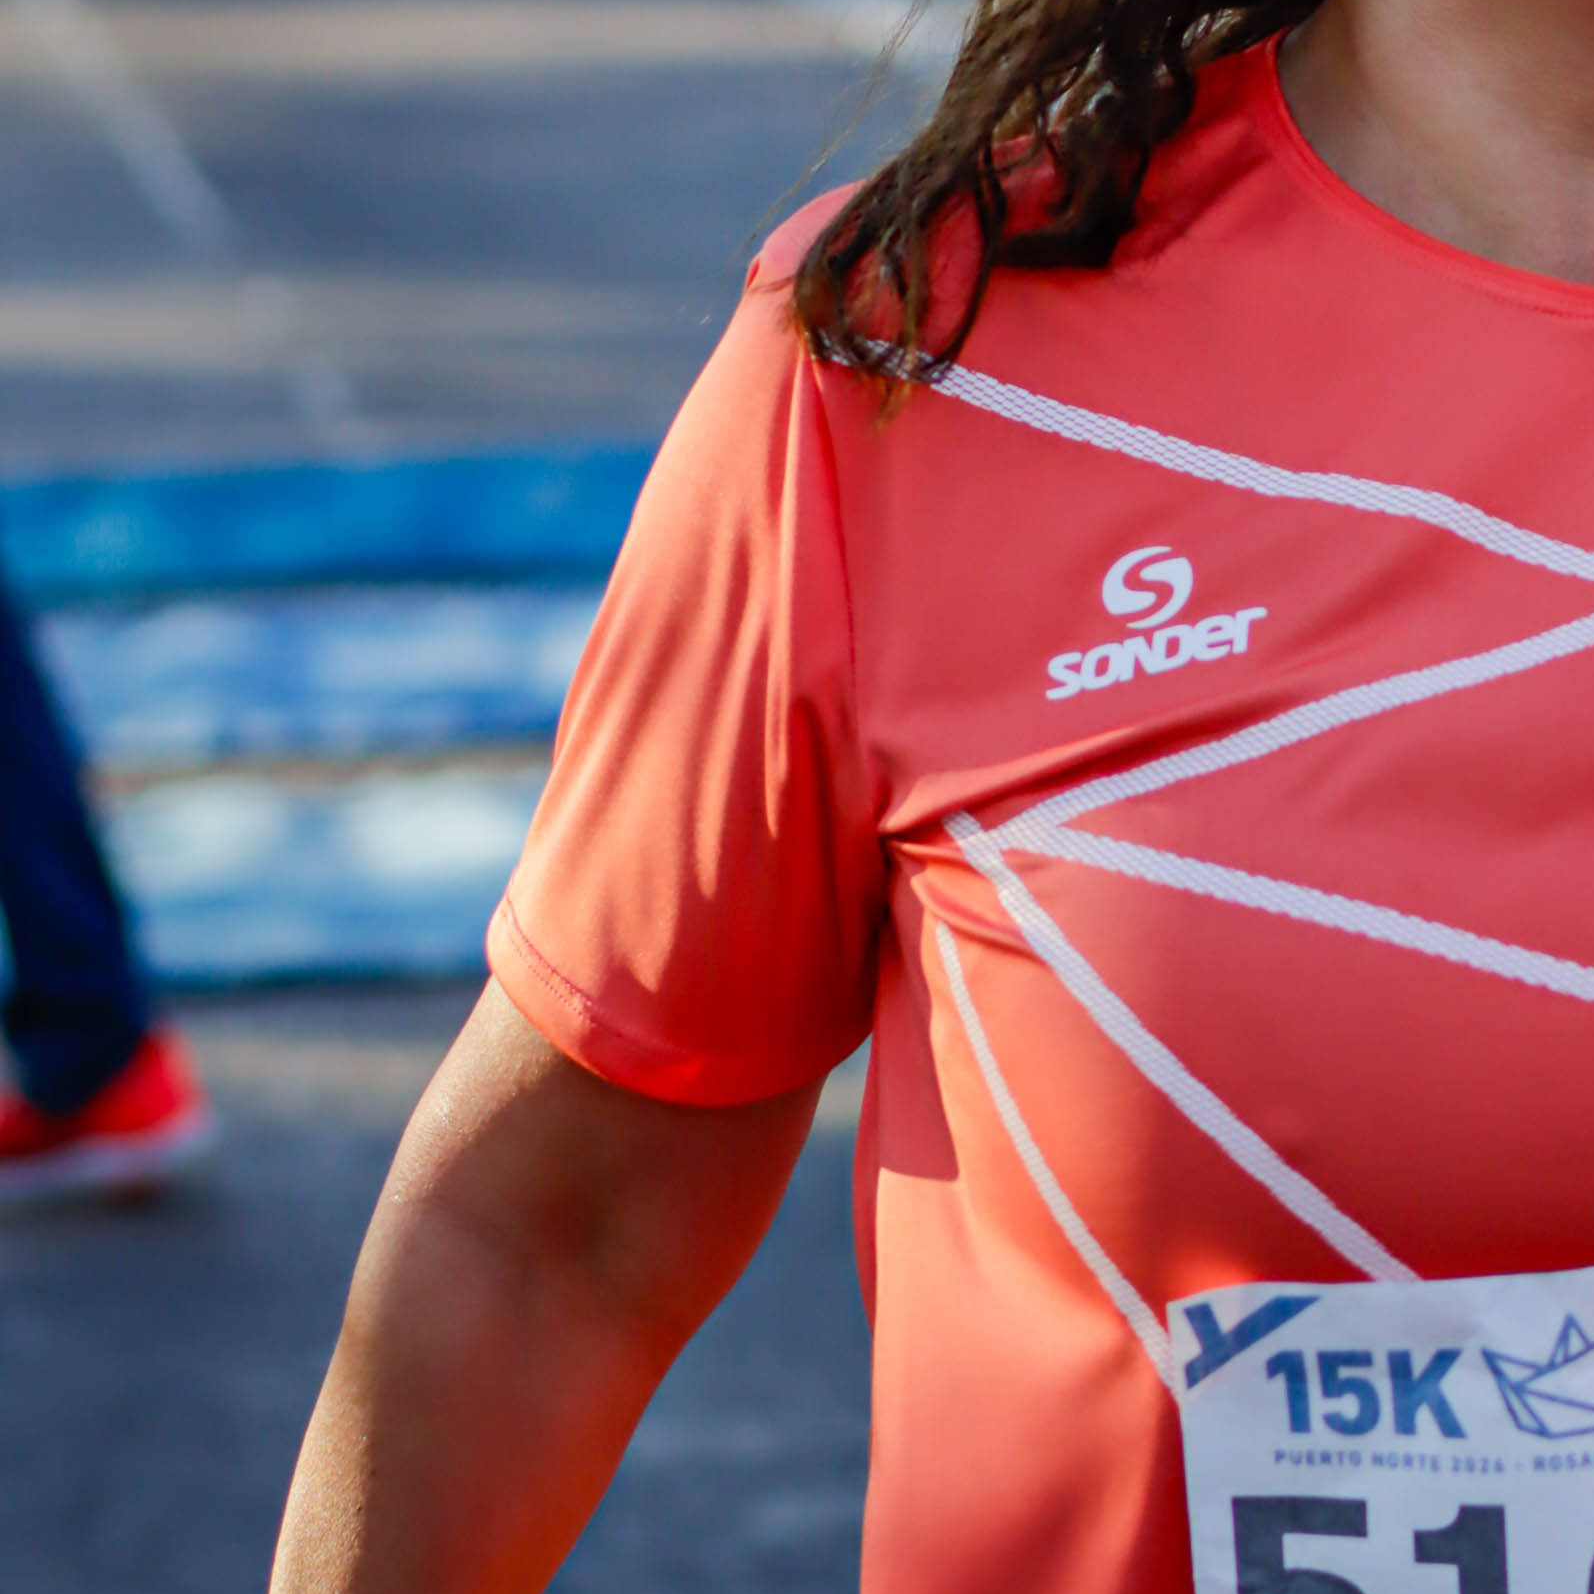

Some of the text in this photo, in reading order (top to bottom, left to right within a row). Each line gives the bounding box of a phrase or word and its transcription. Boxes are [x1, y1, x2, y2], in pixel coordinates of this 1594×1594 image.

[1265, 1348, 1468, 1440] 15K
[1273, 1449, 1363, 1468] PUERTO
[1370, 1452, 1442, 1474] NORTE
